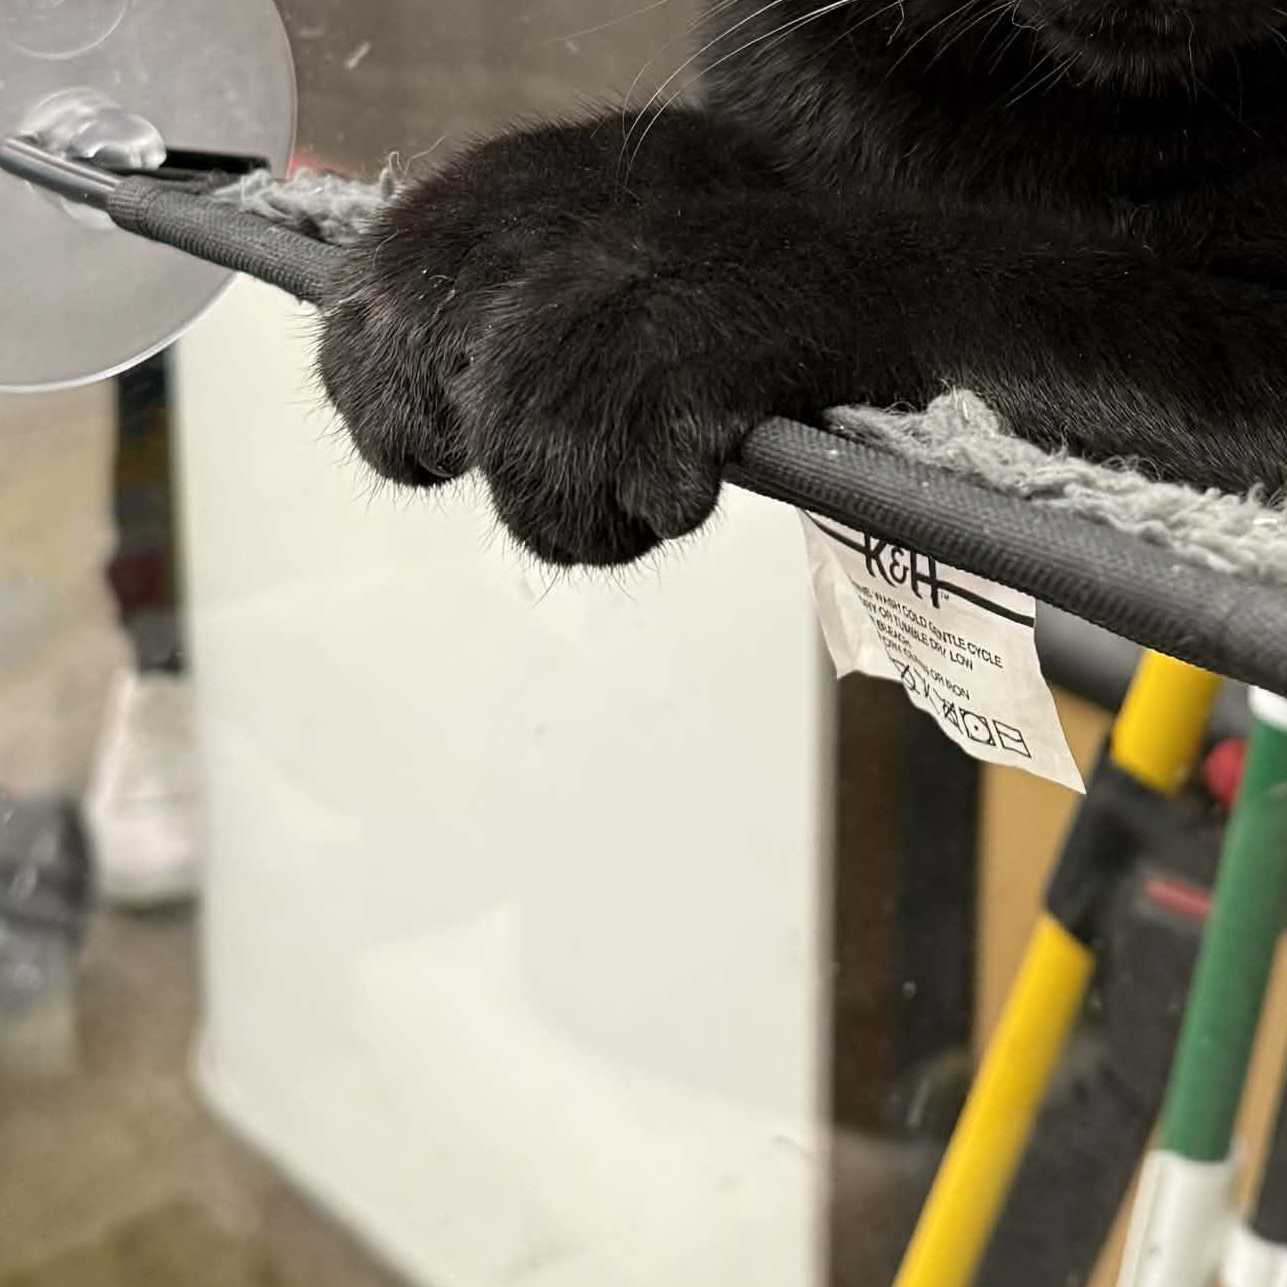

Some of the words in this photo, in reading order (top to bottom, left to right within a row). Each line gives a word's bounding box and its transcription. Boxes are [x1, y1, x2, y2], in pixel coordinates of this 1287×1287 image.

[863, 532, 940, 609] K&H
[893, 614, 929, 647] TUMBLE
[950, 650, 973, 671] LOW
[902, 605, 927, 628] COLD
[928, 621, 966, 651] GENTLE
[967, 643, 1004, 669] CYCLE
